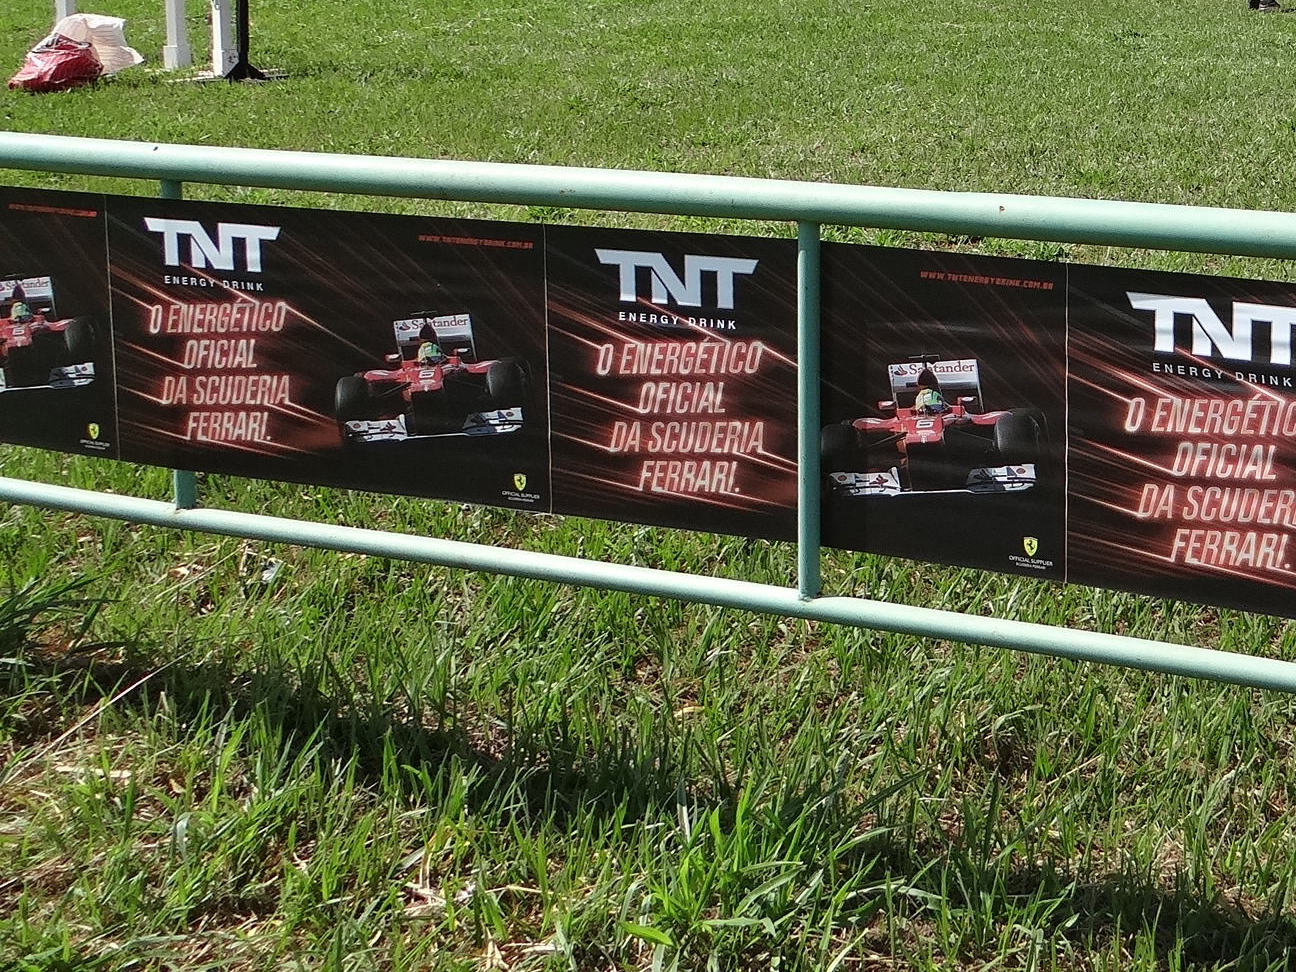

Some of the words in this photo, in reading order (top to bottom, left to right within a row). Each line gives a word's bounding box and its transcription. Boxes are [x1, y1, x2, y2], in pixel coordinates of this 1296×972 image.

[144, 217, 281, 272] TNT
[6, 279, 49, 289] Satander
[164, 275, 216, 288] ENERGY
[223, 280, 264, 291] DRINK
[594, 248, 759, 309] TNT
[149, 304, 163, 334] O
[167, 298, 286, 333] ENERGÉTICO
[411, 316, 469, 330] Satander
[618, 311, 679, 325] ENERGY
[689, 317, 736, 329] DRINK
[184, 339, 257, 369] OFICIAL
[597, 343, 613, 375] O
[619, 337, 763, 375] ENERGÉTICO
[909, 361, 975, 375] Satander
[163, 376, 187, 404] DA
[193, 375, 289, 405] SCUDERIA
[1153, 362, 1224, 379] ENERGY
[1236, 372, 1293, 387] DRINK
[639, 382, 725, 413] OFICIAL
[187, 411, 271, 441] FERRARI.
[1125, 397, 1145, 432] O
[611, 422, 640, 452] DA
[648, 421, 763, 453] SCUDERIA
[1172, 441, 1276, 479] OFICIAL
[639, 461, 740, 492] FERRARI.
[1139, 483, 1174, 518] DA
[1172, 528, 1290, 569] FERRARI.
